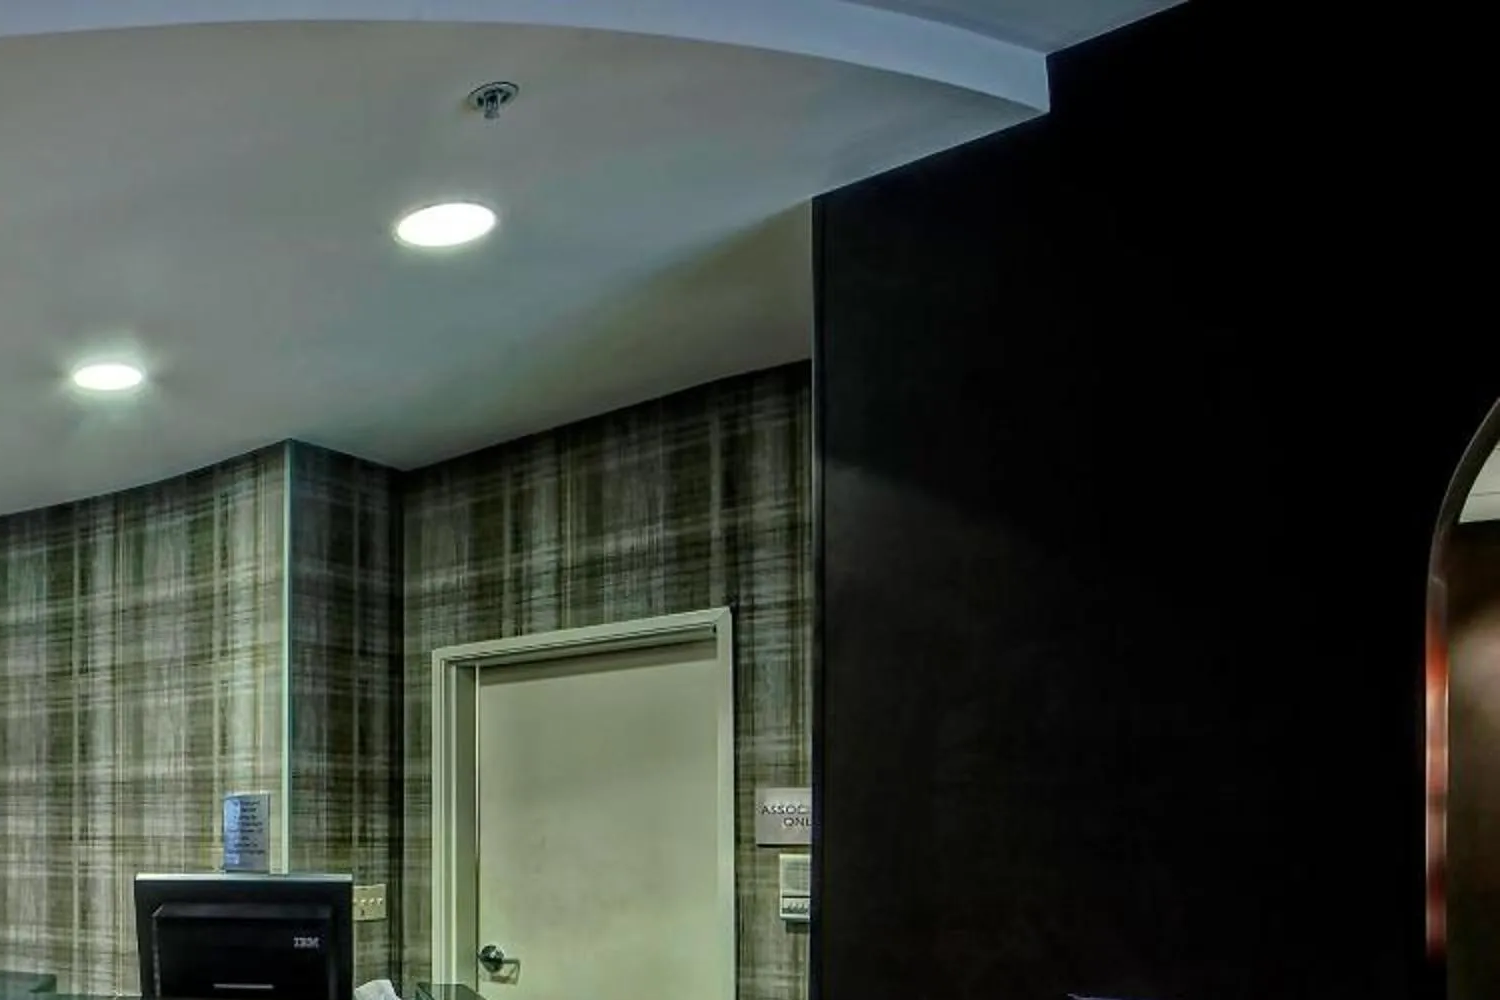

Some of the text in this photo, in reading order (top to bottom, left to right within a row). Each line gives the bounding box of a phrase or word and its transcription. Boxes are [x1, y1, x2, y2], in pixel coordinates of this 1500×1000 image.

[761, 803, 811, 815] ASSOC
[783, 816, 812, 827] ONL
[293, 936, 319, 949] IBM
